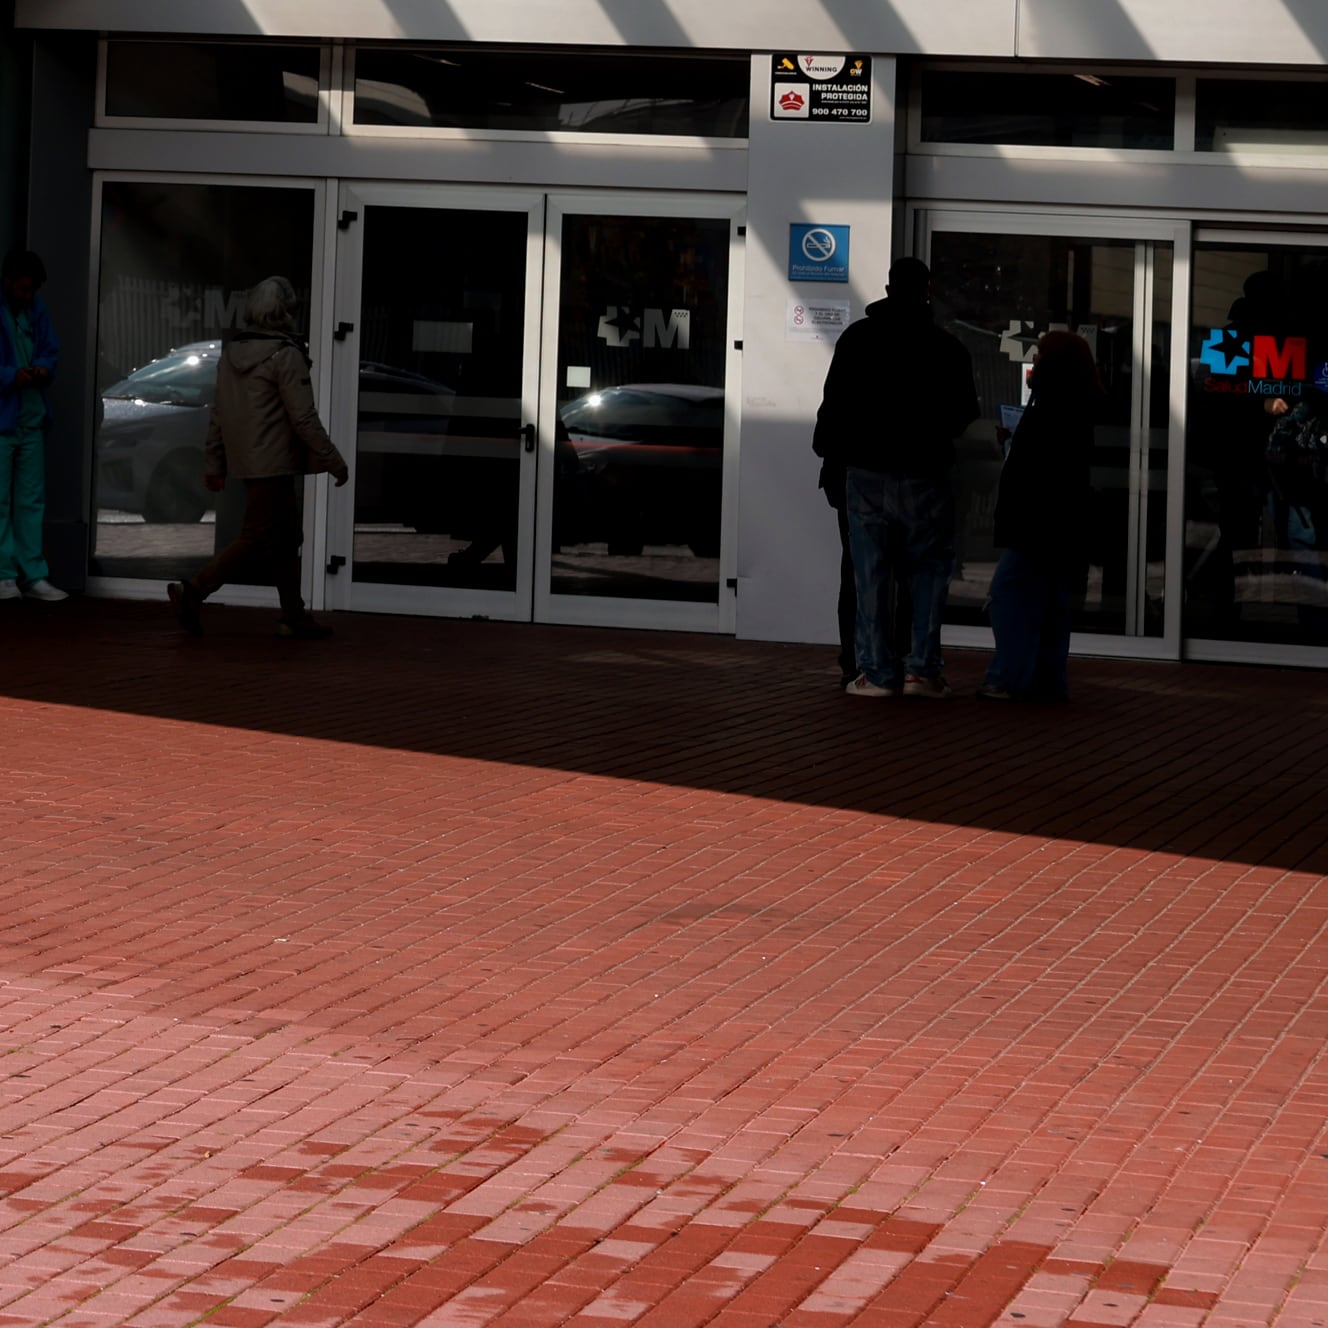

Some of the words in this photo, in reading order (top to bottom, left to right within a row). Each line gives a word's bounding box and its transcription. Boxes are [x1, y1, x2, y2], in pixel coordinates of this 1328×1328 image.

[812, 83, 868, 92] INSTALACIÓN
[821, 92, 868, 101] PROTEGIDA
[831, 108, 848, 116] 470
[1252, 334, 1307, 381] M
